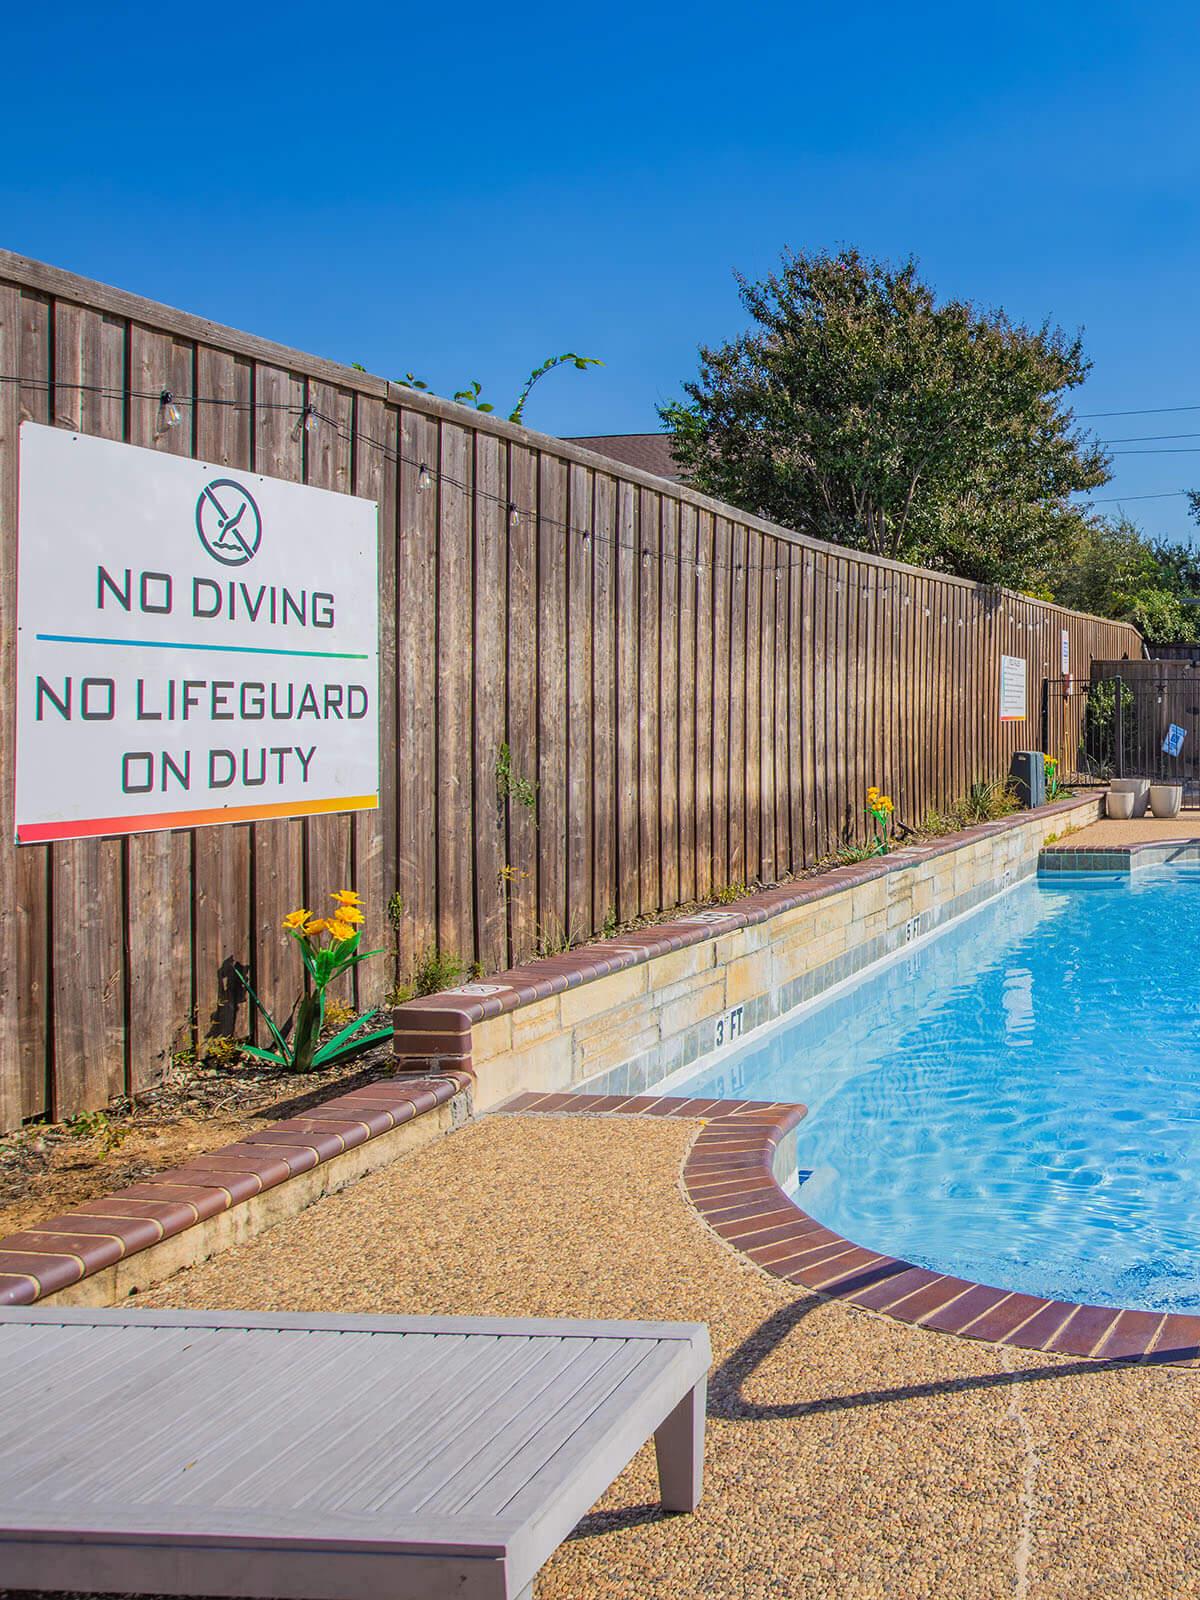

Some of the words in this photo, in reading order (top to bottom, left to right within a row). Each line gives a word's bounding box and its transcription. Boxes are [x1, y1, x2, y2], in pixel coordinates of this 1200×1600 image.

[97, 565, 172, 614] NO
[192, 576, 335, 629] DIVING
[35, 675, 115, 721] NO
[136, 678, 369, 721] LIFEGUARD
[122, 750, 191, 794] ON
[208, 745, 317, 789] DUTY
[906, 923, 911, 941] 5
[913, 917, 920, 938] FT
[716, 1020, 724, 1047] 3
[730, 1006, 743, 1040] FT
